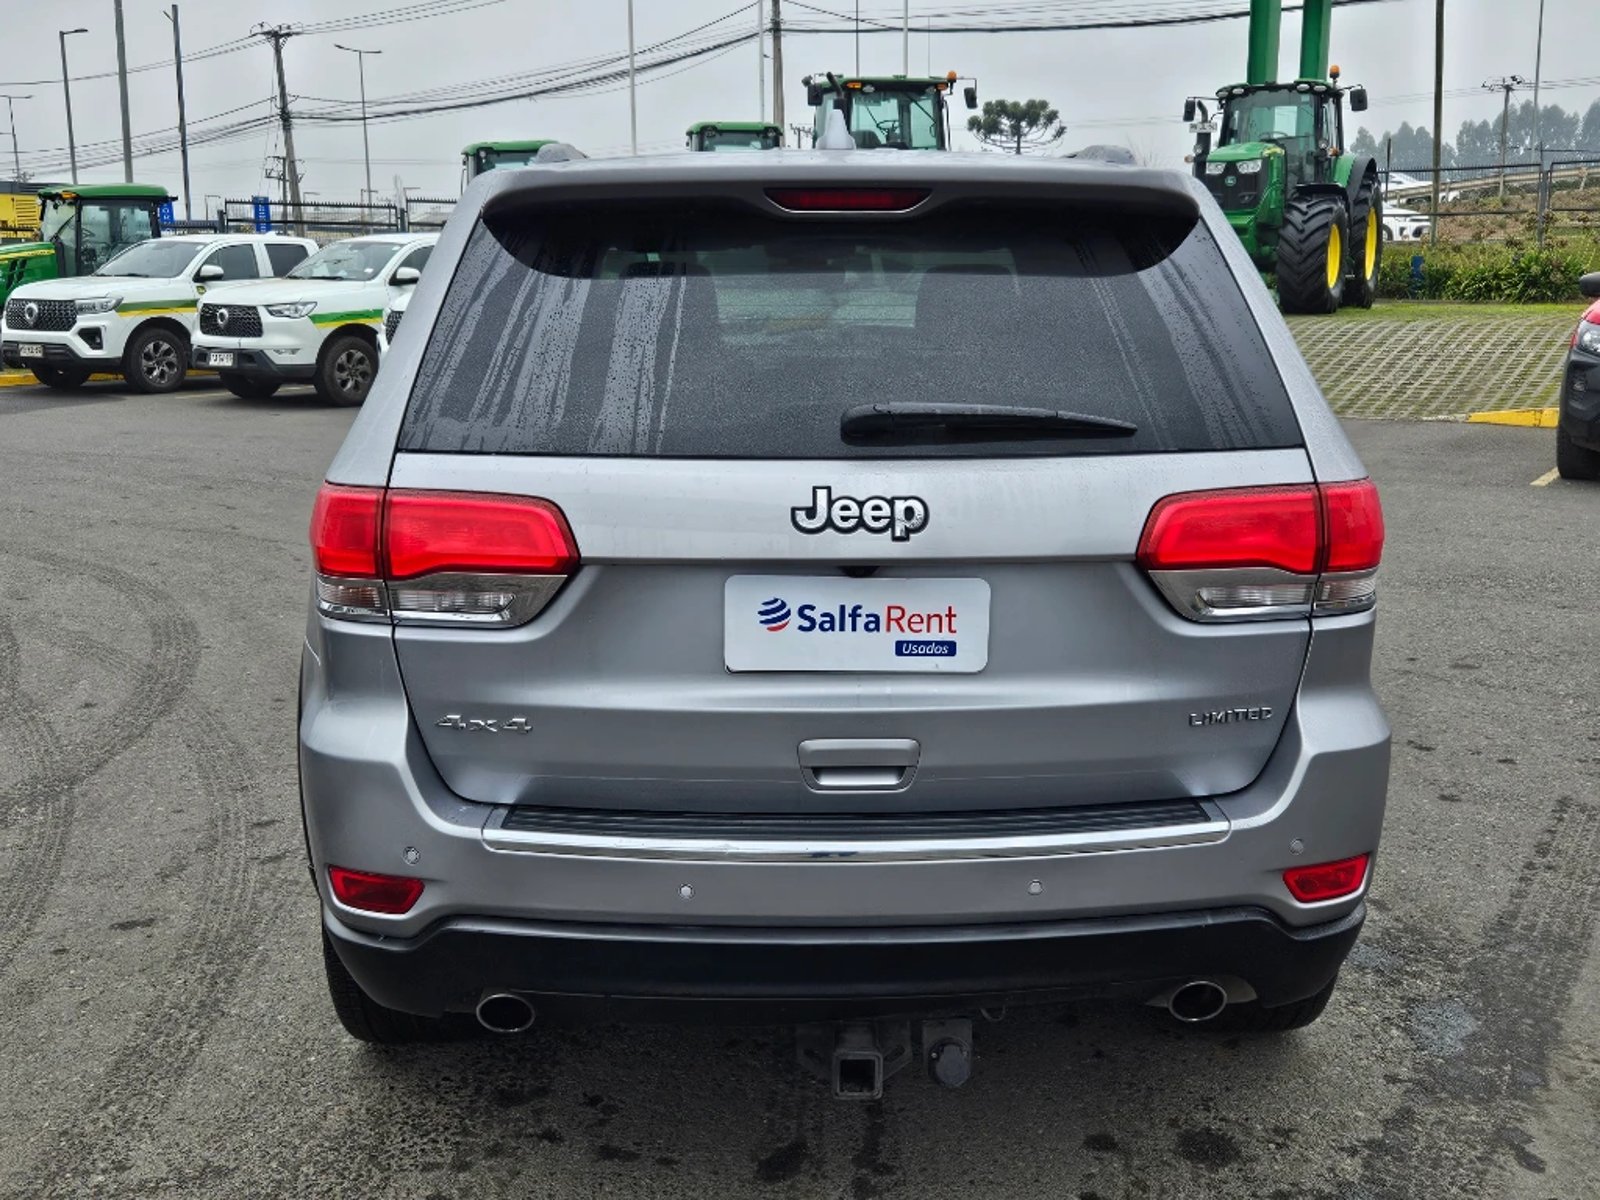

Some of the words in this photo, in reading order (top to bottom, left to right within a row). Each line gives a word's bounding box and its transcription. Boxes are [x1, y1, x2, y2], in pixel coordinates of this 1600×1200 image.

[791, 486, 930, 541] Jeep
[797, 603, 957, 633] SalfaRent
[902, 642, 949, 655] Usados
[436, 715, 532, 733] 4x4
[1189, 707, 1272, 726] LIMITED
